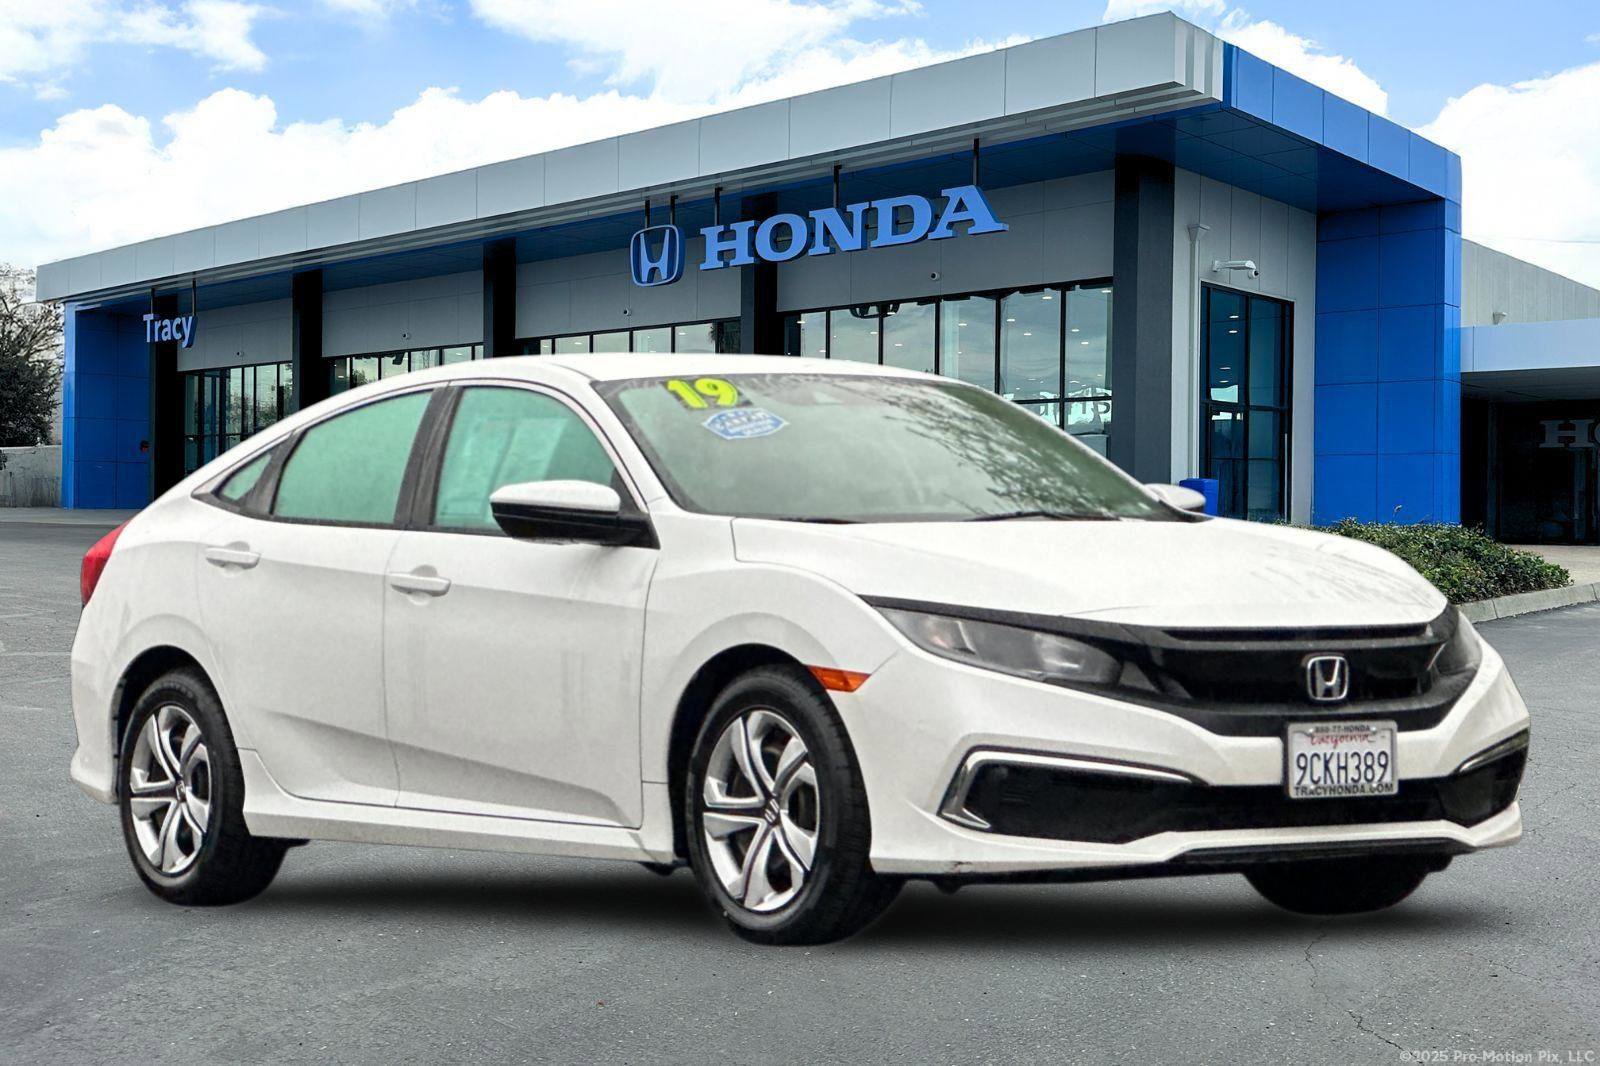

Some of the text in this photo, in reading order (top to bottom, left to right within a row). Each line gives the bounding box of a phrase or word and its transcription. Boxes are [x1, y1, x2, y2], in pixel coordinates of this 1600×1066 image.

[699, 185, 1010, 271] HONDA
[142, 313, 194, 349] Tracy
[666, 377, 740, 409] 19
[1539, 418, 1600, 448] H
[1296, 750, 1389, 786] 9CKH389
